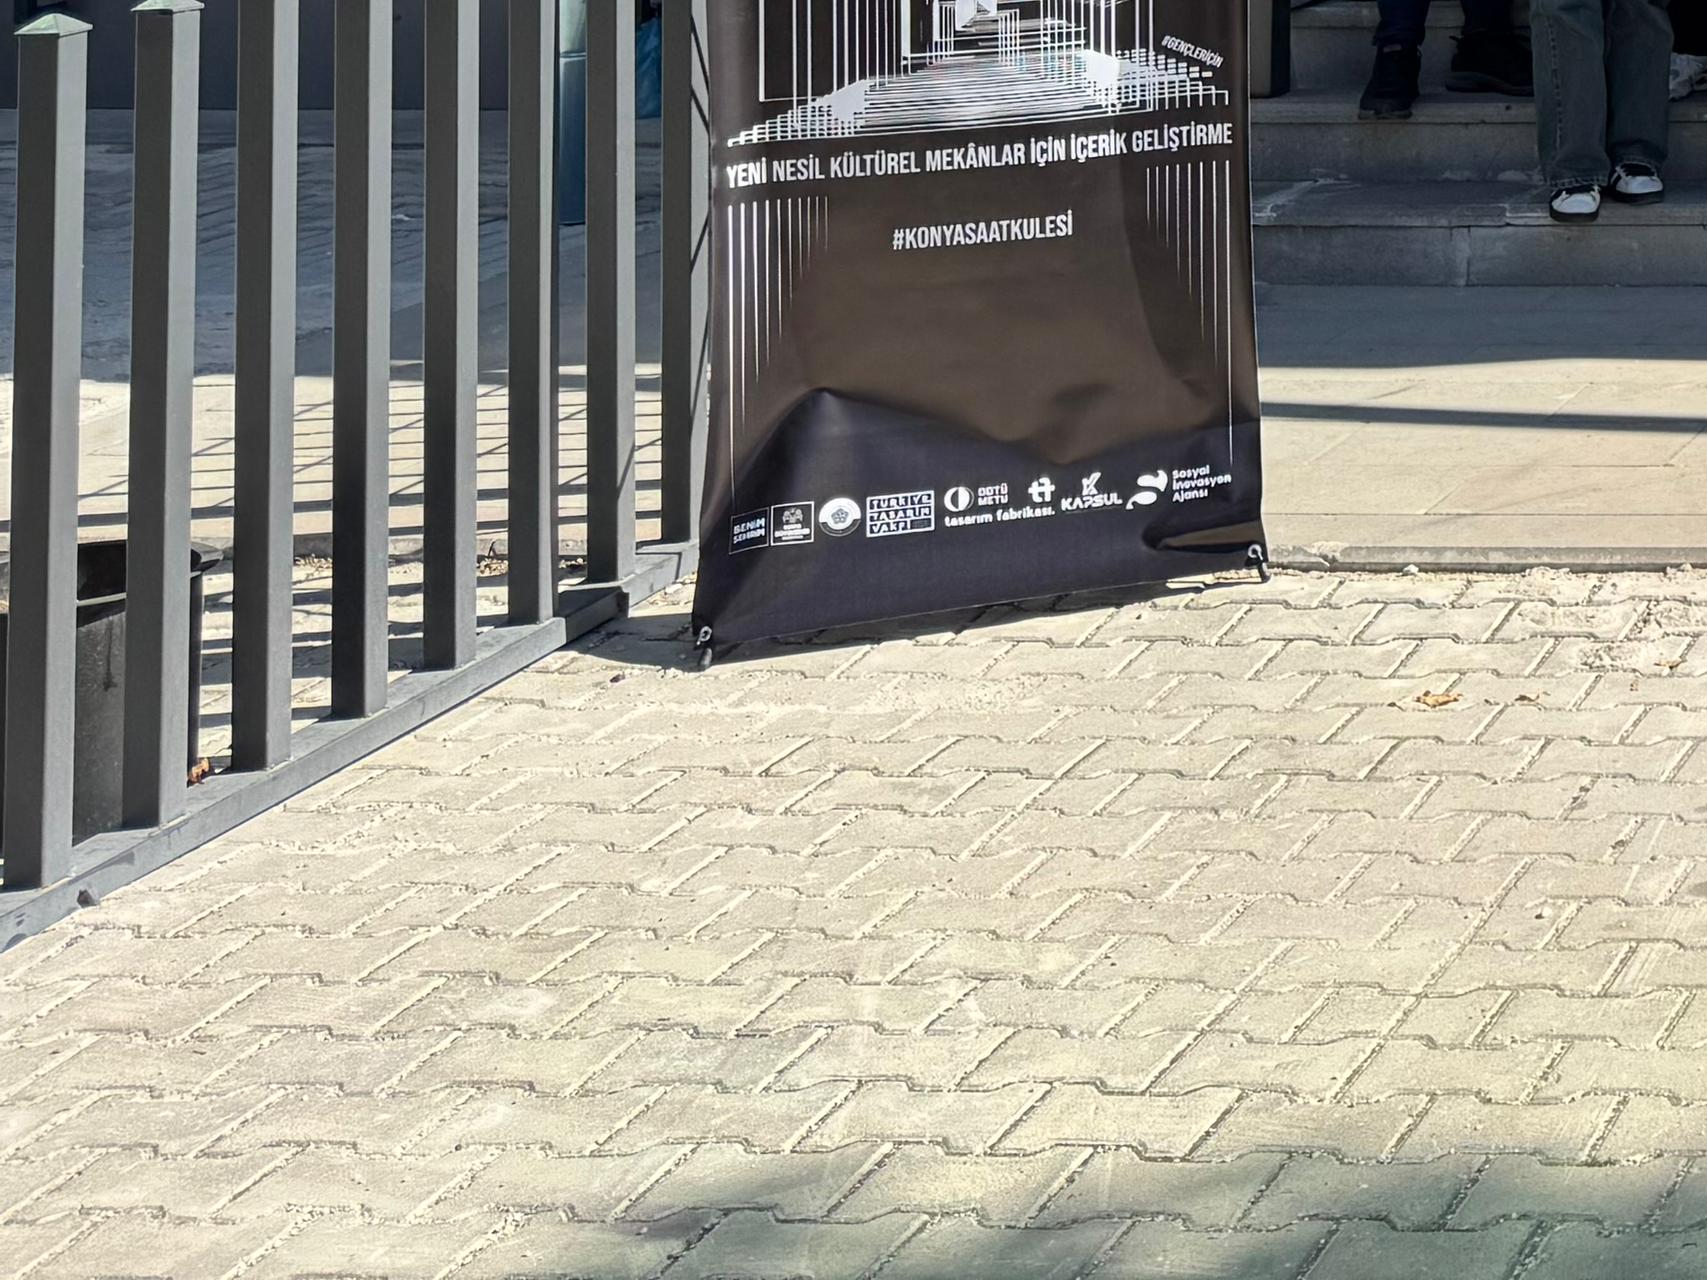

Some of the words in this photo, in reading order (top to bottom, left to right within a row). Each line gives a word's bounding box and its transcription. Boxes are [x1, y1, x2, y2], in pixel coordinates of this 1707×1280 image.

[726, 157, 768, 189] YENİ
[773, 154, 825, 183] NESİL
[830, 150, 921, 178] KÜLTÜREL
[926, 142, 1025, 172] MEKÂNLAR
[1030, 135, 1066, 167] İÇİN
[1070, 128, 1128, 163] İÇERİK
[1133, 120, 1233, 152] GELİŞTİRME
[893, 209, 1073, 251] #KONYASAATKULESİ
[1172, 464, 1210, 479] Sosyal
[1172, 488, 1208, 502] Ajansı
